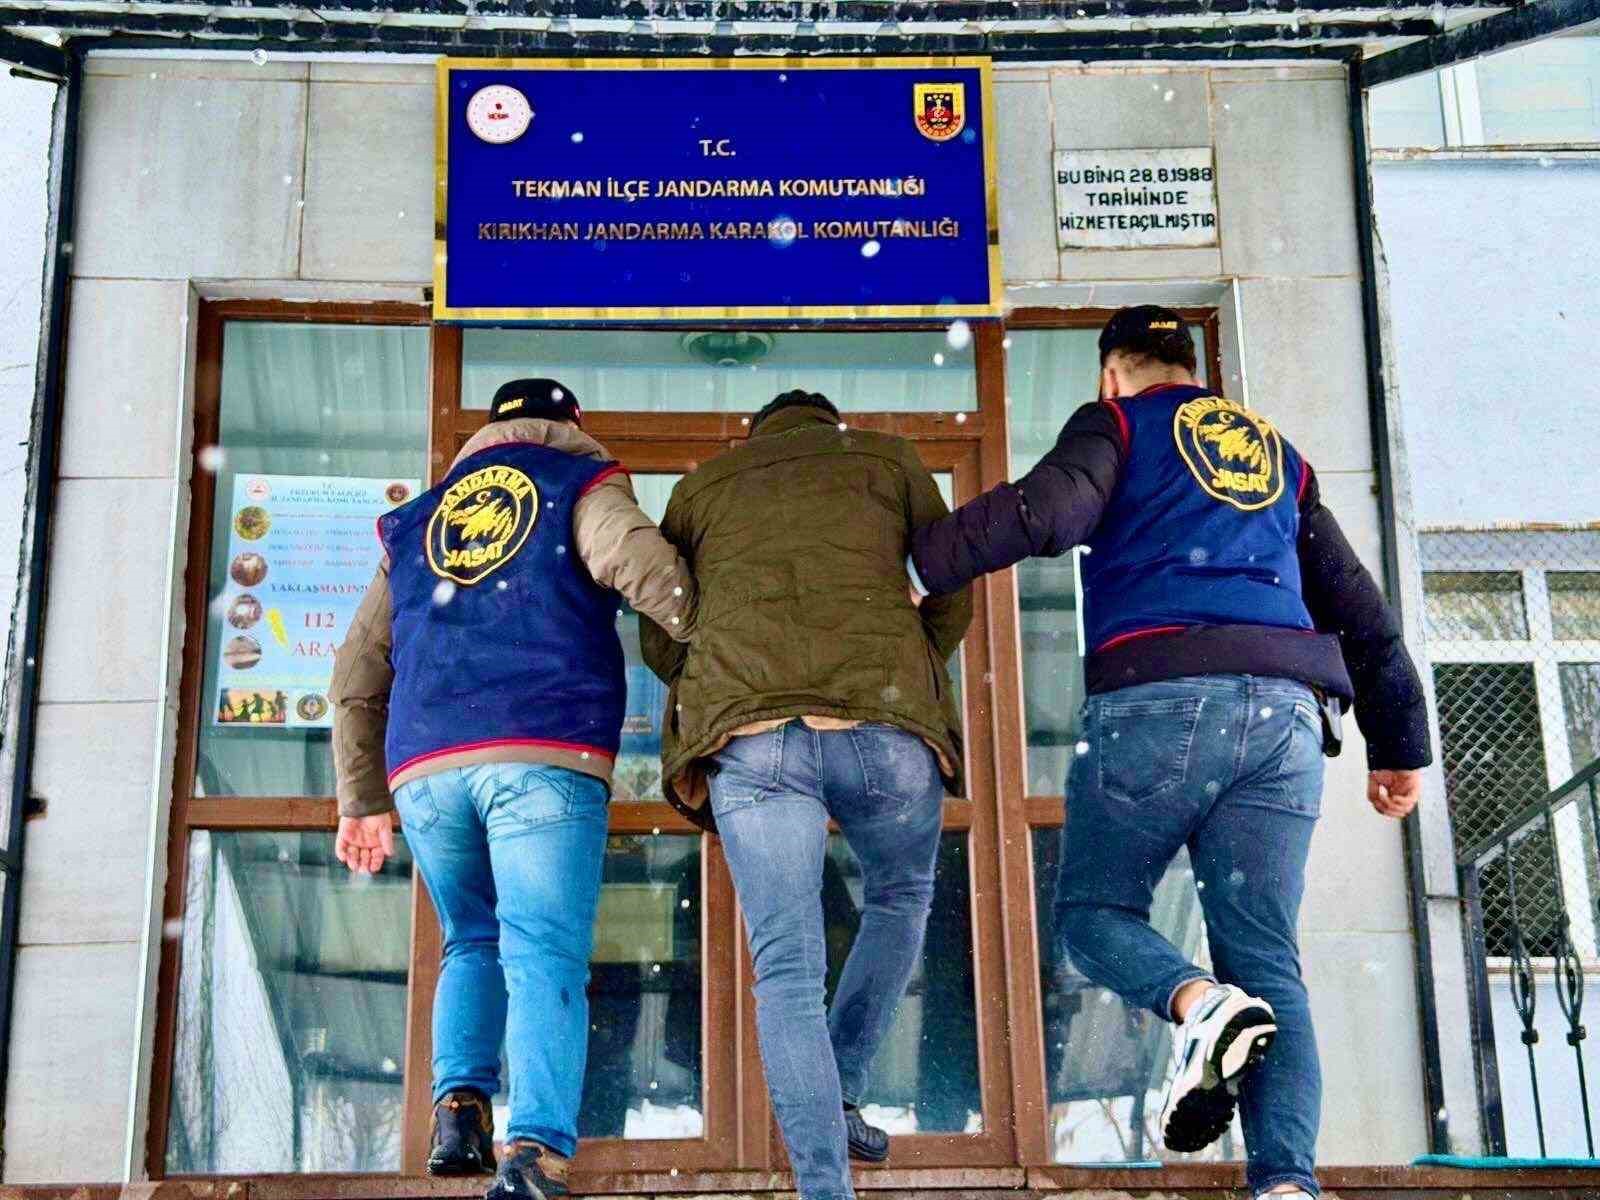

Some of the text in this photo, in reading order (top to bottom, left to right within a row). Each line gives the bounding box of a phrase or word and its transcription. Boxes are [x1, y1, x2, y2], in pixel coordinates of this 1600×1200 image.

[699, 139, 737, 156] T.C.
[1058, 169, 1081, 184] BU
[1084, 165, 1125, 183] BİNA
[512, 176, 925, 202] TEKMAN İLÇE JANDARMA KOMUTANLIĞI
[1086, 186, 1189, 206] TARİHİNDE
[478, 217, 958, 240] KIRIKHAN JANDARMA KARAKOL KOMUTANLIĞI
[1060, 212, 1216, 232] HİZMETE AÇILMIŞTIR
[1212, 468, 1269, 493] JASAT
[441, 469, 532, 518] JANDARMA
[443, 541, 503, 568] JASAT
[304, 612, 336, 628] 112
